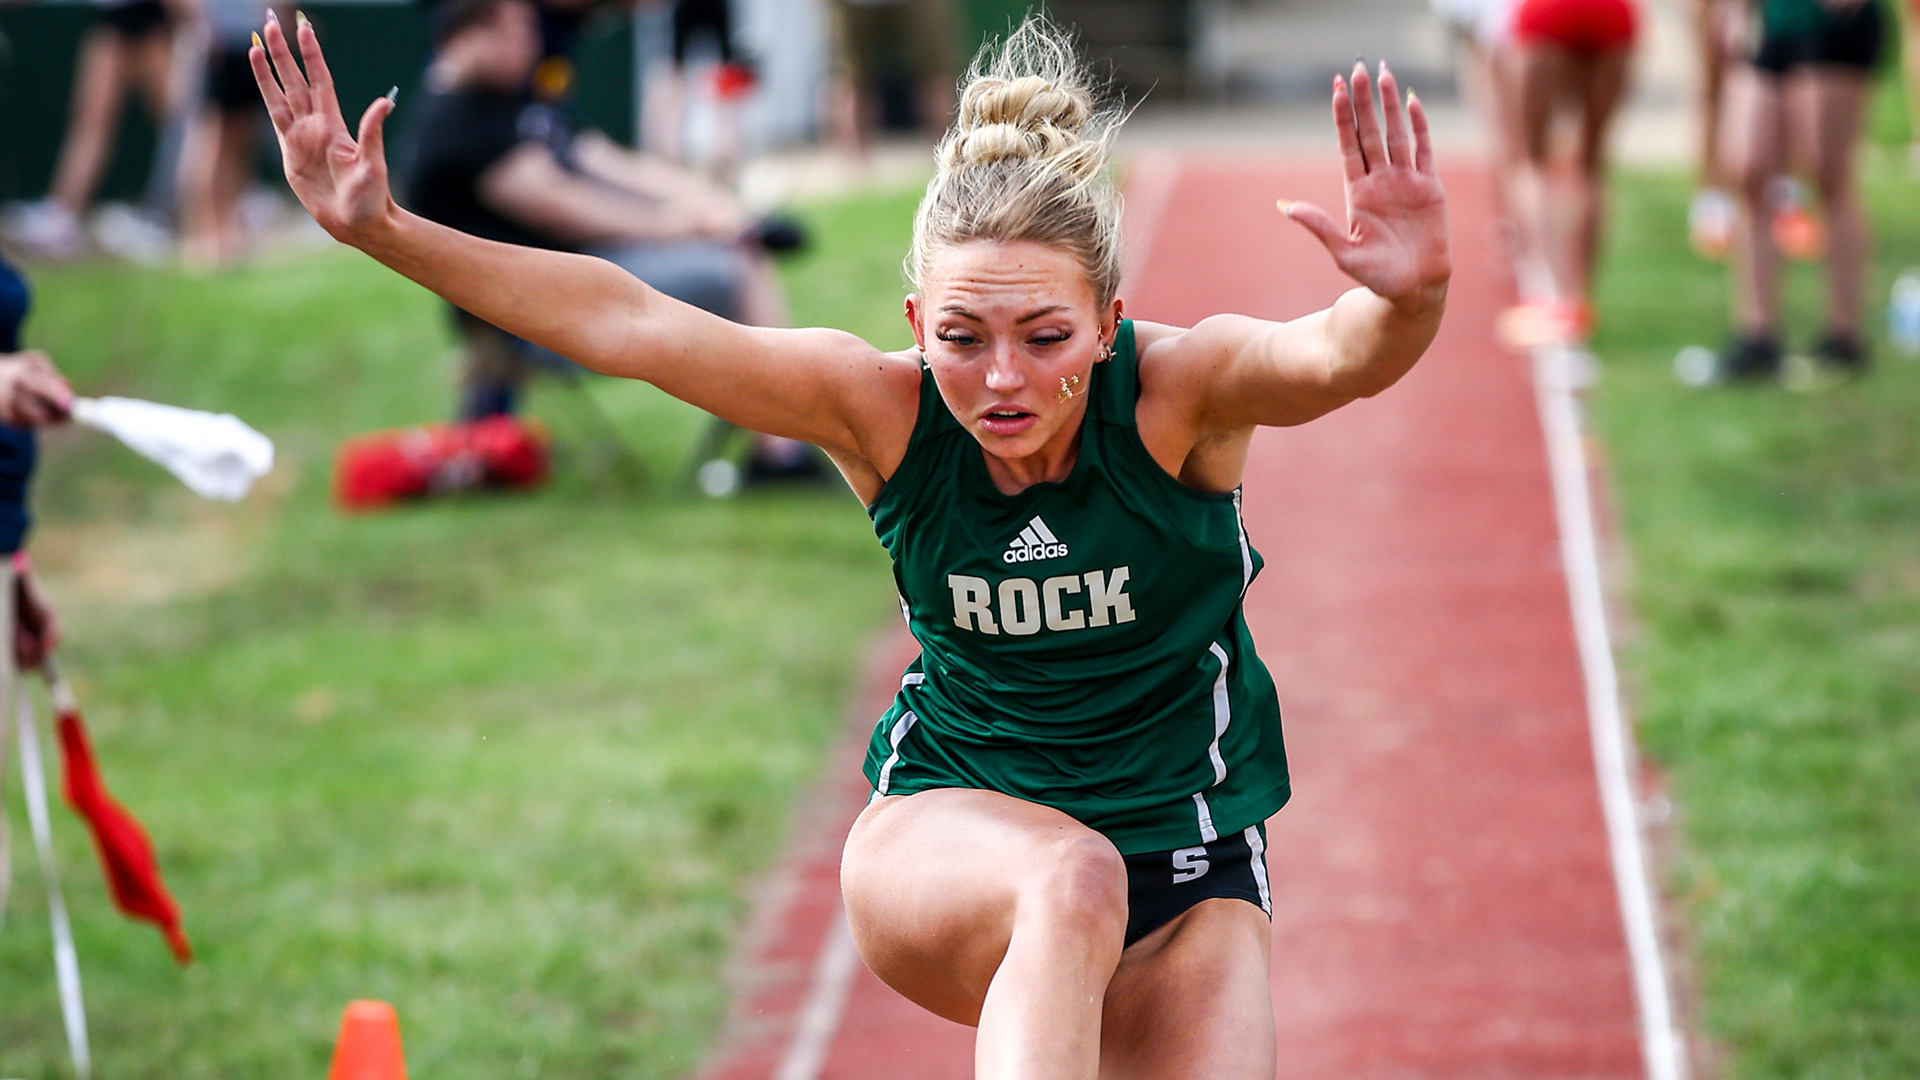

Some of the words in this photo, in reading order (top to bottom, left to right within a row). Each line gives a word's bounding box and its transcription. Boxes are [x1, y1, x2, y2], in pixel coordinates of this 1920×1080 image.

[1003, 541, 1068, 563] adidas
[948, 566, 1136, 636] ROCK
[1172, 846, 1210, 884] S
